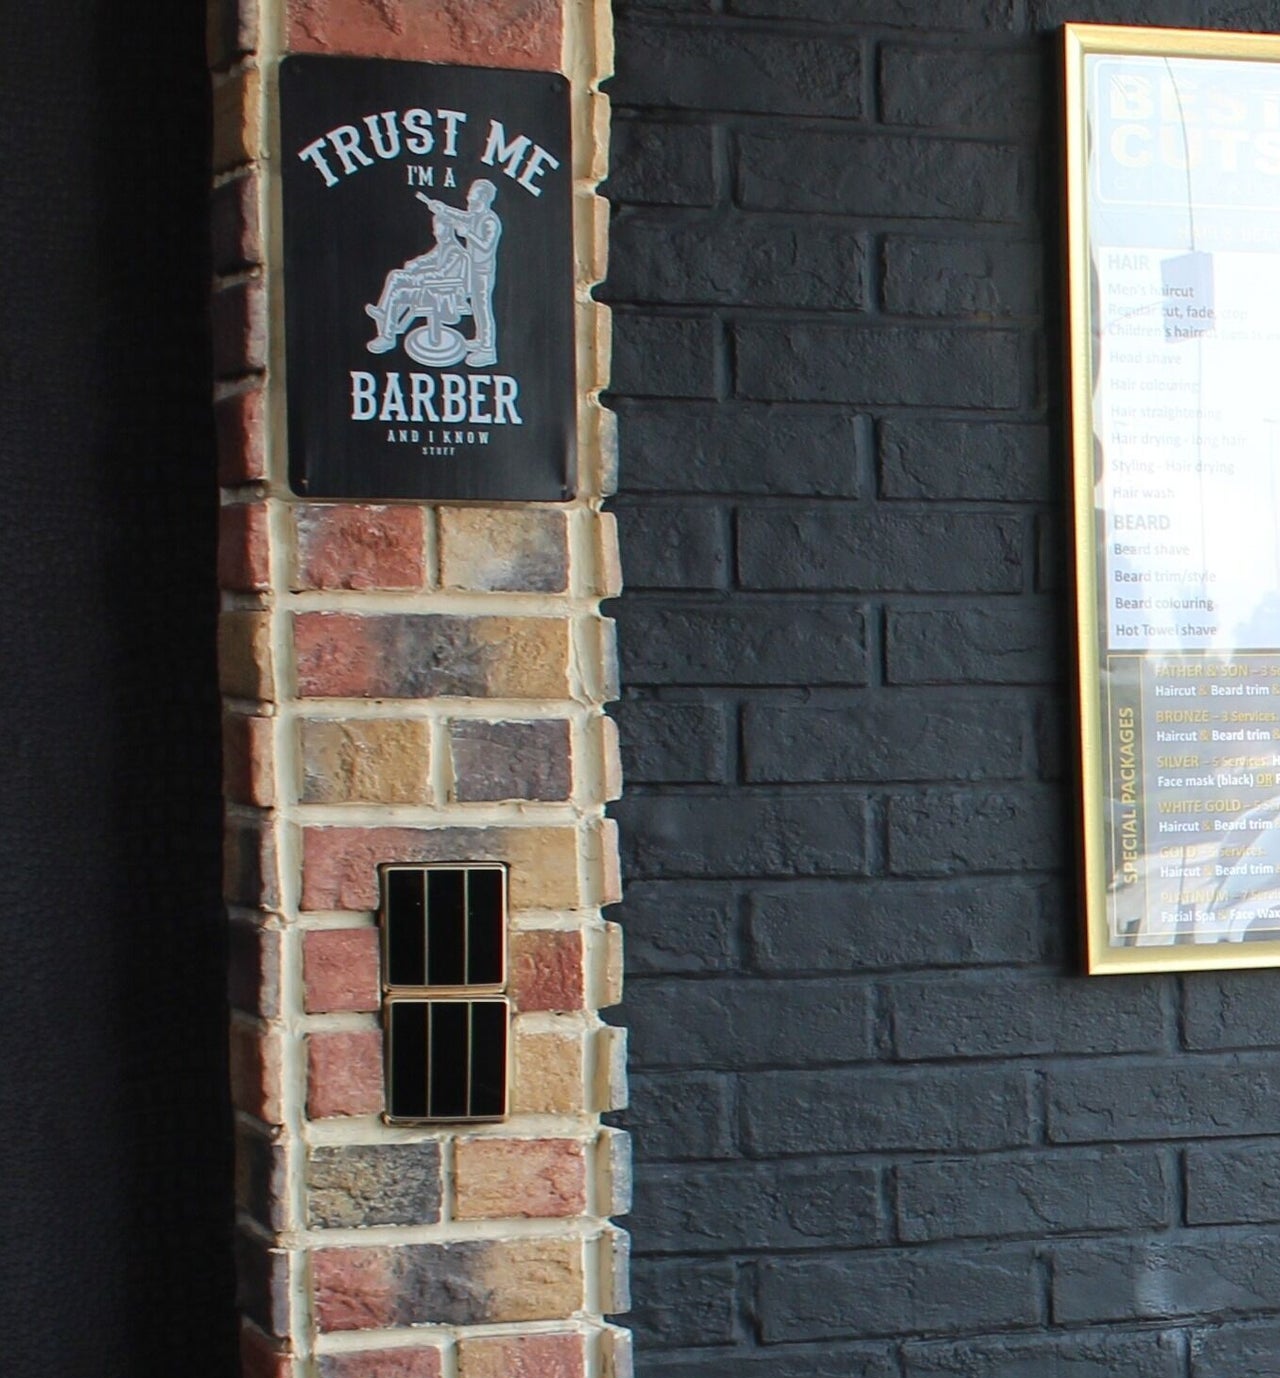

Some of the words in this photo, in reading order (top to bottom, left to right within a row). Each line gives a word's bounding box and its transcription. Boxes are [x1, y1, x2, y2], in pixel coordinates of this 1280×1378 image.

[298, 108, 467, 188] TRUST
[481, 119, 560, 197] ME
[407, 164, 434, 187] I'M
[443, 167, 456, 188] A
[1108, 254, 1150, 271] HAIR
[350, 371, 522, 424] BARBER
[387, 429, 419, 443] AND
[429, 430, 434, 443] I
[443, 431, 489, 444] KNOW
[422, 447, 455, 456] STUFF
[1113, 486, 1138, 499] Hair
[1141, 486, 1176, 500] wash
[1114, 514, 1171, 531] BEARD
[1114, 543, 1151, 556] Beard
[1154, 543, 1191, 556] shave
[1114, 570, 1151, 583] Beard
[1115, 597, 1152, 610] Beard
[1155, 596, 1215, 613] colouring
[1115, 624, 1140, 637] Hot
[1141, 623, 1180, 637] Towel
[1180, 623, 1217, 637] shave
[1154, 664, 1201, 679] FATHER
[1219, 664, 1248, 678] SON
[1155, 684, 1197, 697] Haircut
[1210, 683, 1244, 696] Beard
[1246, 683, 1270, 696] trim
[1155, 709, 1210, 724] BRONZE
[1156, 730, 1198, 743] Haircut
[1211, 729, 1244, 742] Beard
[1246, 729, 1271, 742] trim
[1119, 706, 1136, 805] PACKAGES
[1156, 755, 1199, 769] SILVER
[1157, 775, 1183, 788] Face
[1185, 774, 1214, 787] mask
[1216, 772, 1254, 788] (black)
[1255, 774, 1273, 788] OR
[1157, 800, 1202, 814] WHITE
[1204, 799, 1242, 813] GOLD
[1159, 820, 1200, 833] Haircut
[1213, 819, 1247, 832] Beard
[1249, 818, 1273, 831] trim
[1122, 808, 1138, 884] SPECIAL
[1160, 865, 1201, 878] Haircut
[1214, 864, 1248, 877] Beard
[1250, 863, 1274, 876] trim
[1160, 910, 1193, 924] Facial
[1194, 910, 1216, 924] Spa
[1230, 908, 1255, 921] Face
